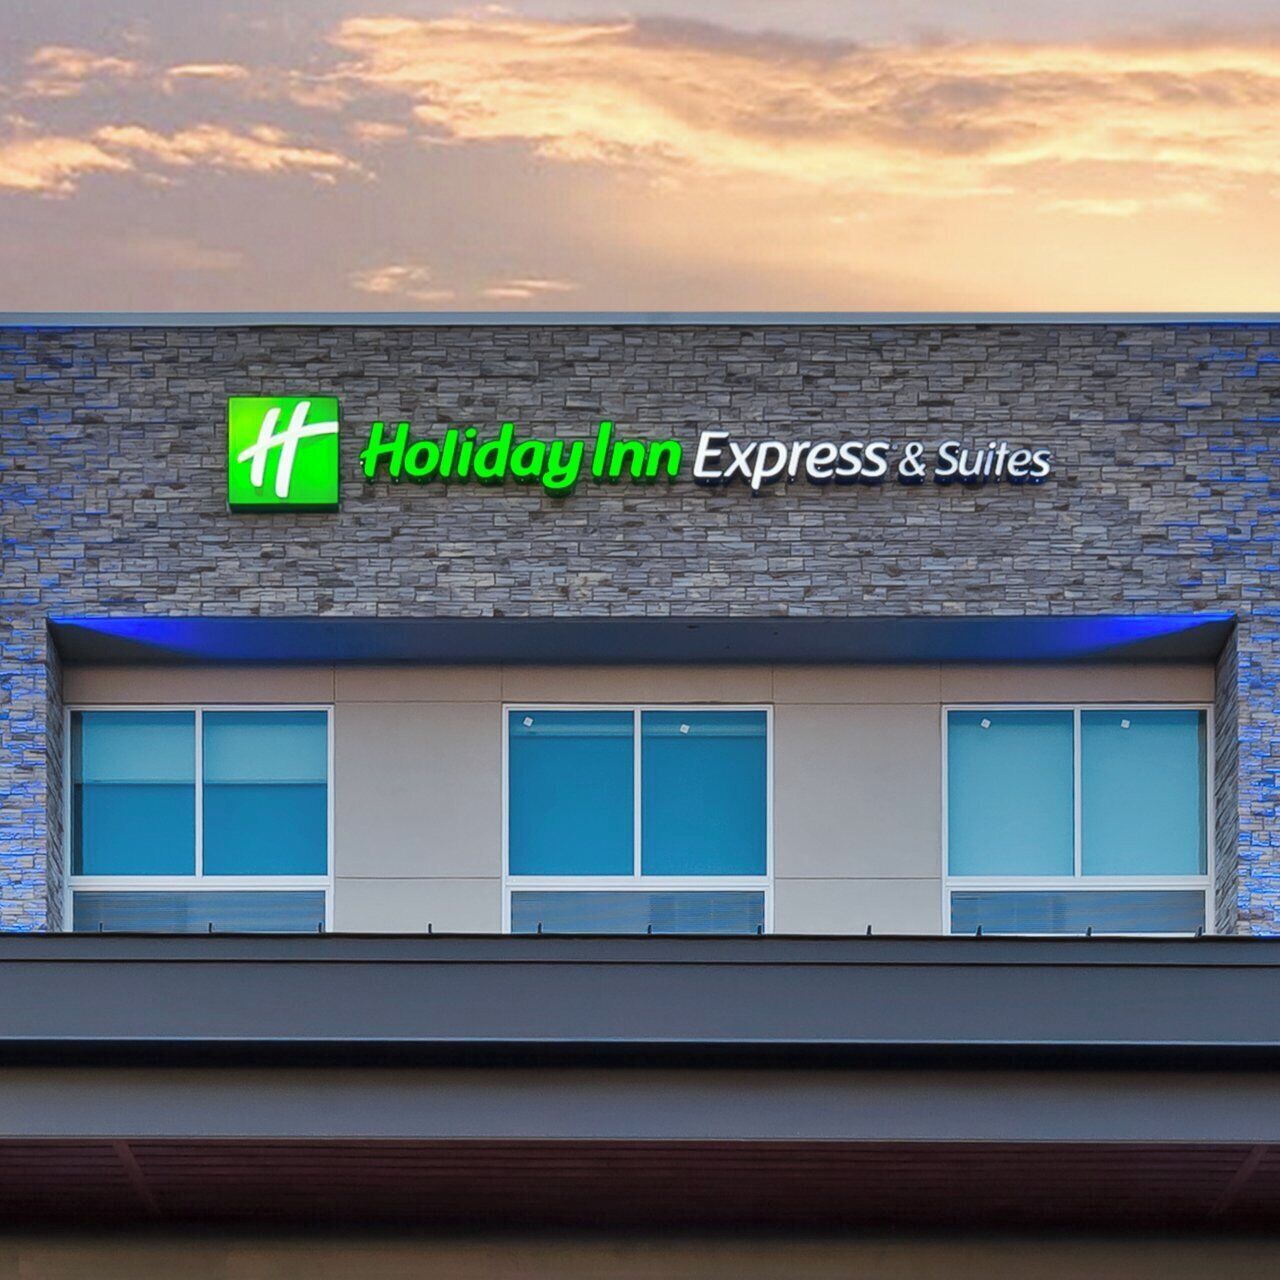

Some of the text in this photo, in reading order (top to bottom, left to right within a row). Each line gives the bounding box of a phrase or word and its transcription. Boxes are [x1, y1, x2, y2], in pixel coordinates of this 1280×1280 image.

[360, 421, 1051, 490] Holiday Inn Express & Suites
